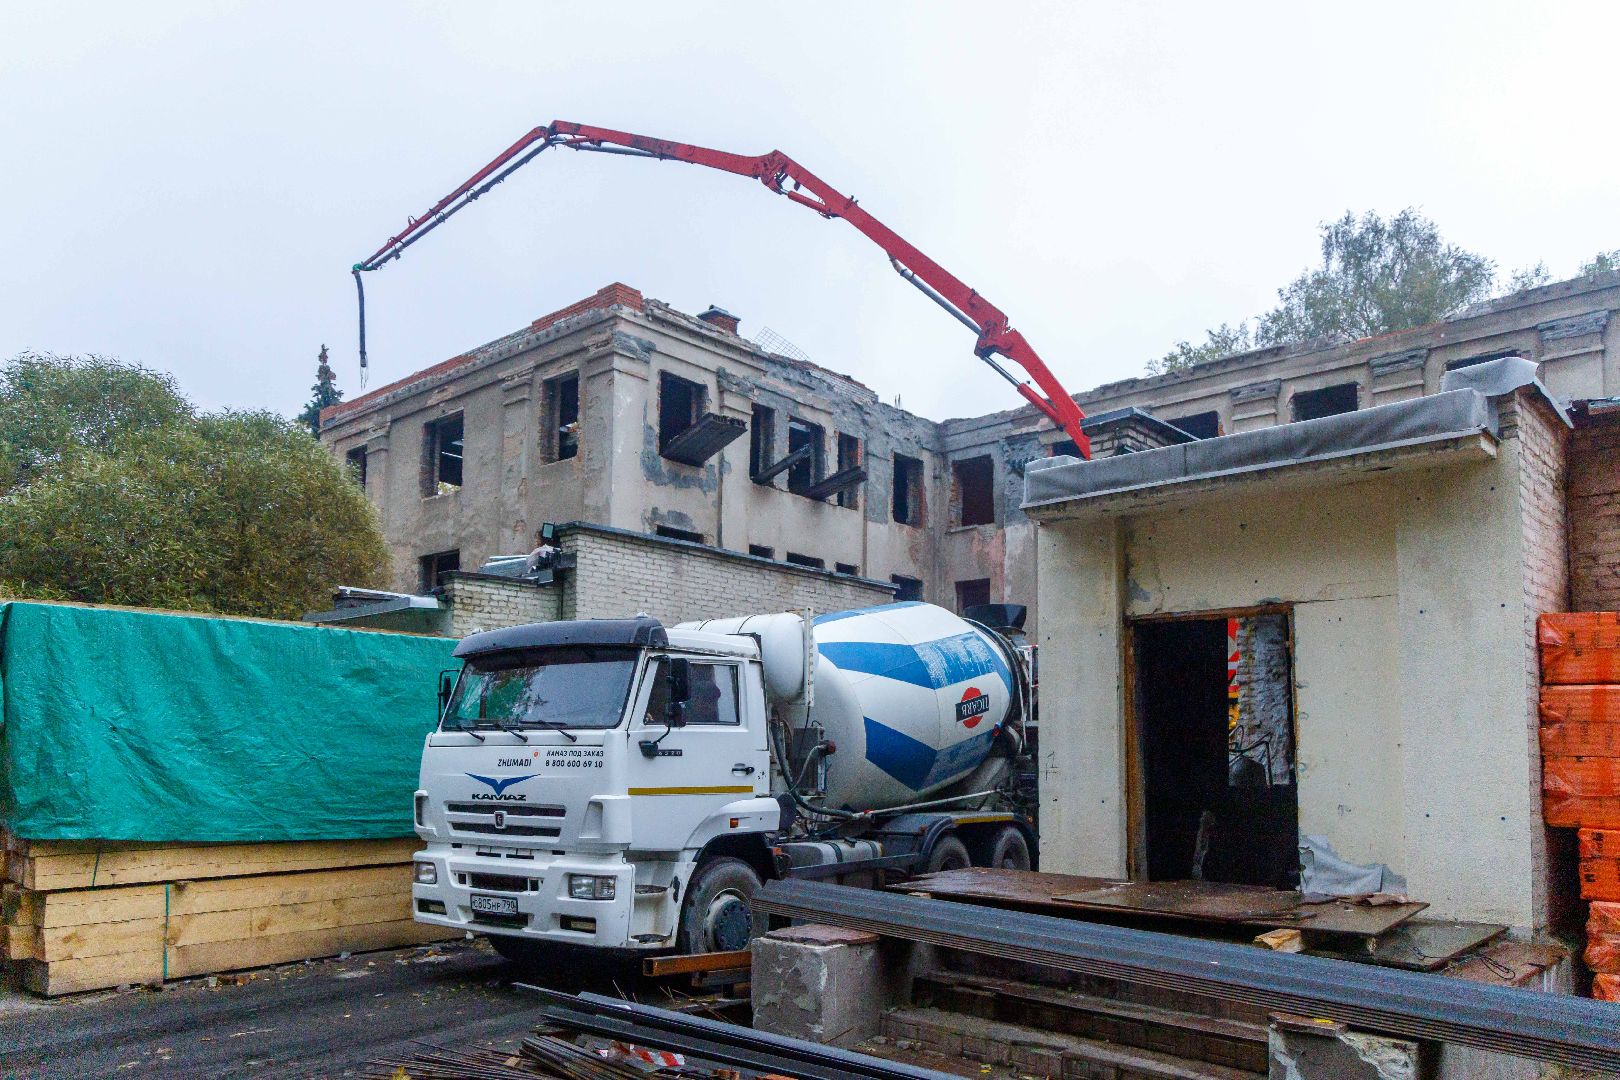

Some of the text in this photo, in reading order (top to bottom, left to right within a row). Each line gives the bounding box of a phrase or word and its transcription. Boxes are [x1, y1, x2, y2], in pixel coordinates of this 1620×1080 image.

[568, 750, 582, 758] ПОД
[497, 758, 532, 767] ZHUMADI
[567, 760, 581, 768] 600
[583, 760, 593, 768] 69
[471, 793, 527, 801] KAMAZ
